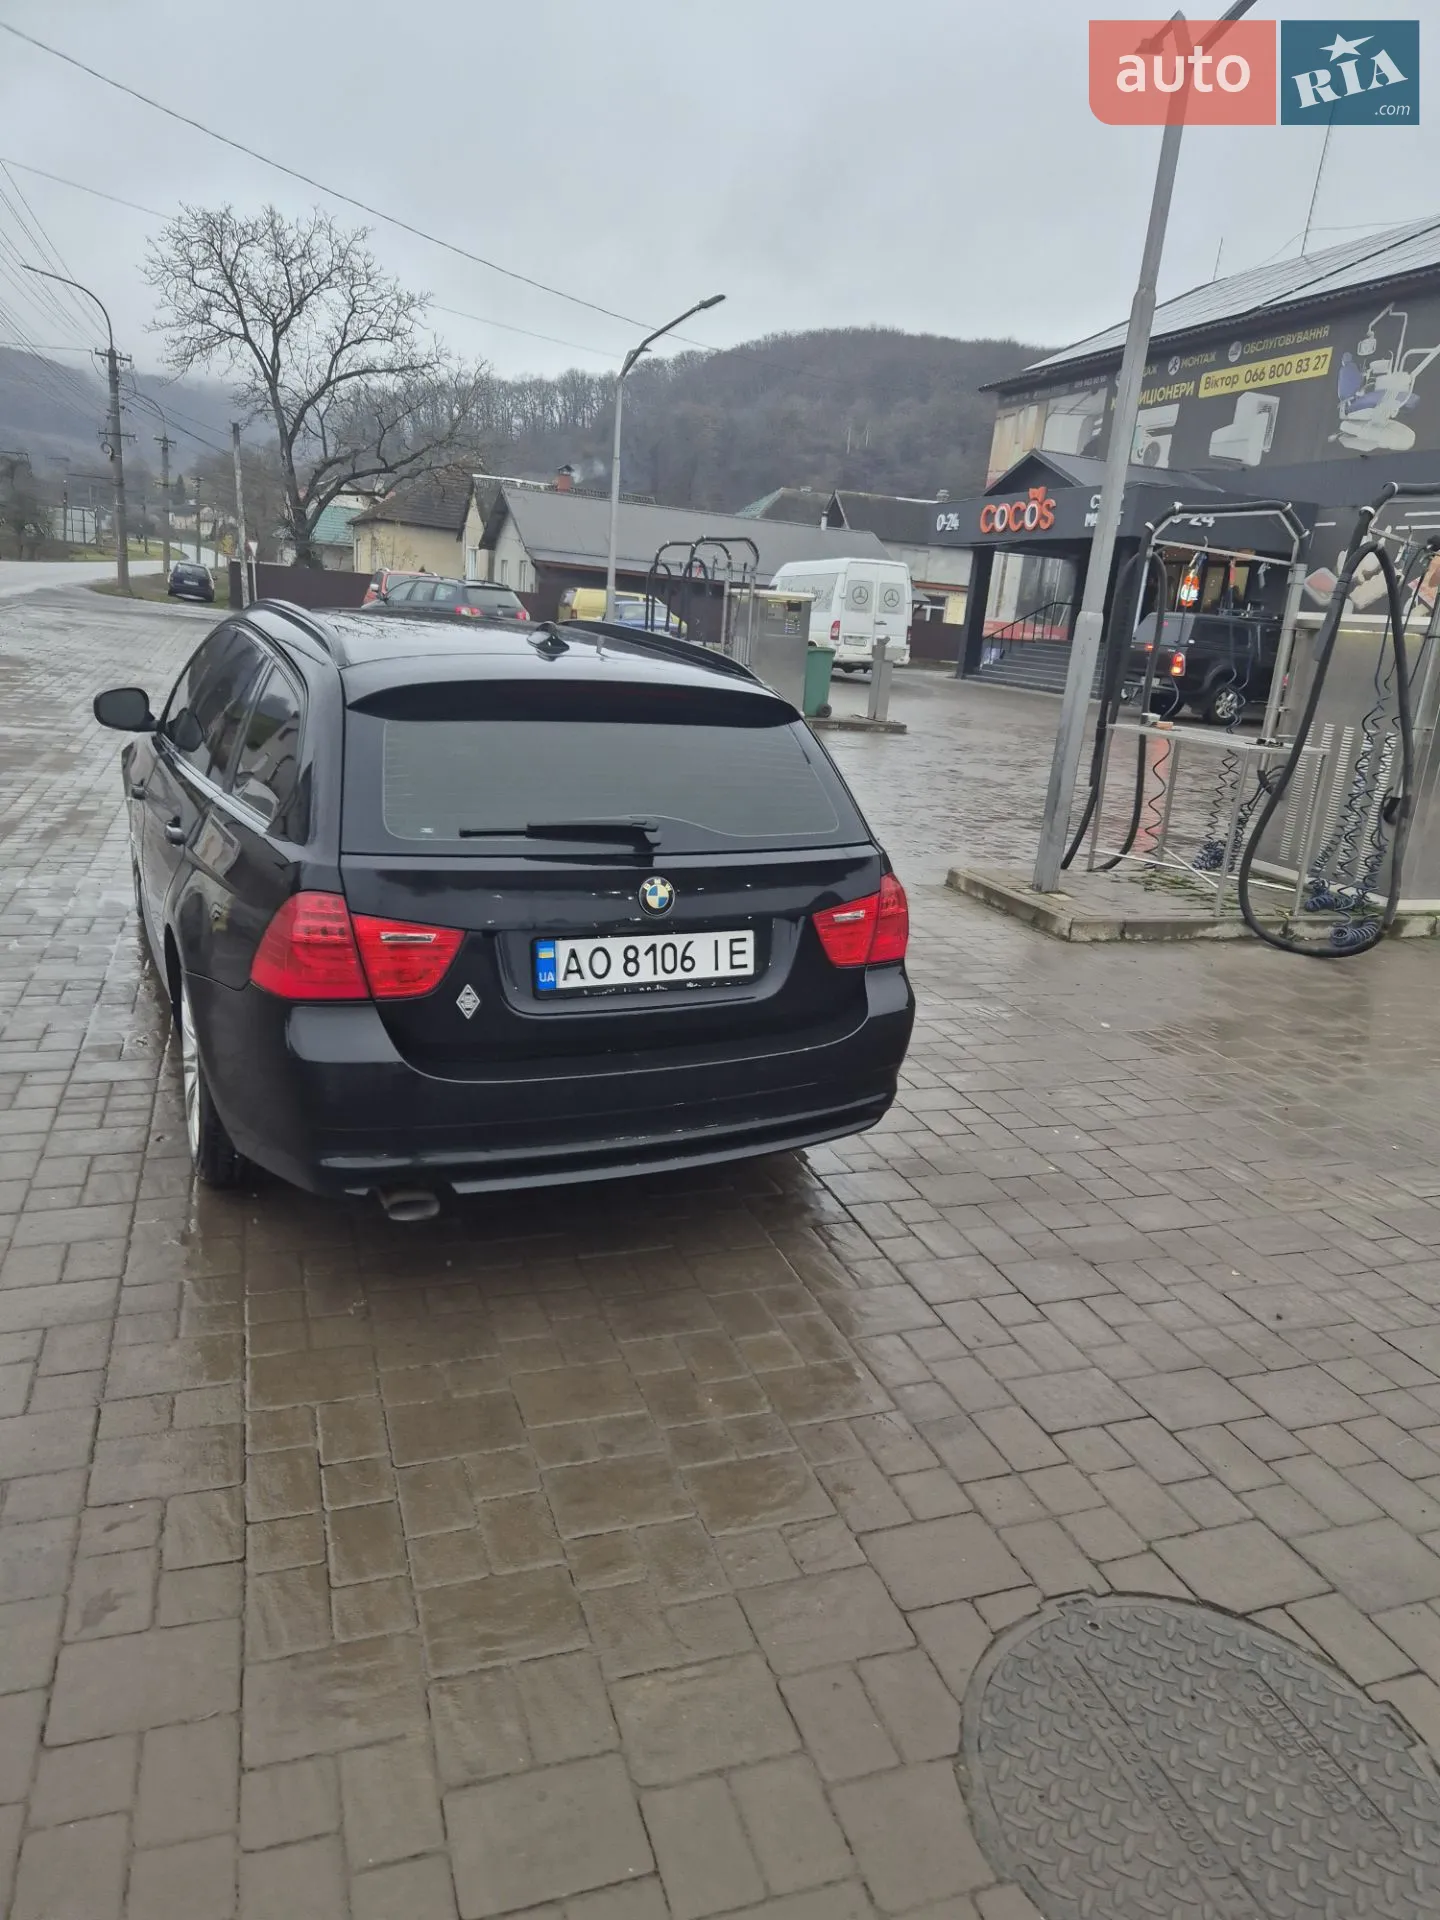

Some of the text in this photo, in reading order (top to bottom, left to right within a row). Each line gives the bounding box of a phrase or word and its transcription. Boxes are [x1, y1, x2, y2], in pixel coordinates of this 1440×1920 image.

[1180, 352, 1217, 368] МОНТАЖ
[1243, 325, 1330, 354] ОБСЛУГОВУВАННЯ
[1204, 374, 1240, 390] Віктор
[1244, 367, 1265, 384] 066
[1268, 361, 1293, 379] 800
[1295, 357, 1311, 374] 83
[1313, 354, 1329, 370] 27
[538, 971, 555, 983] UA
[562, 937, 748, 981] AO 8106 IE
